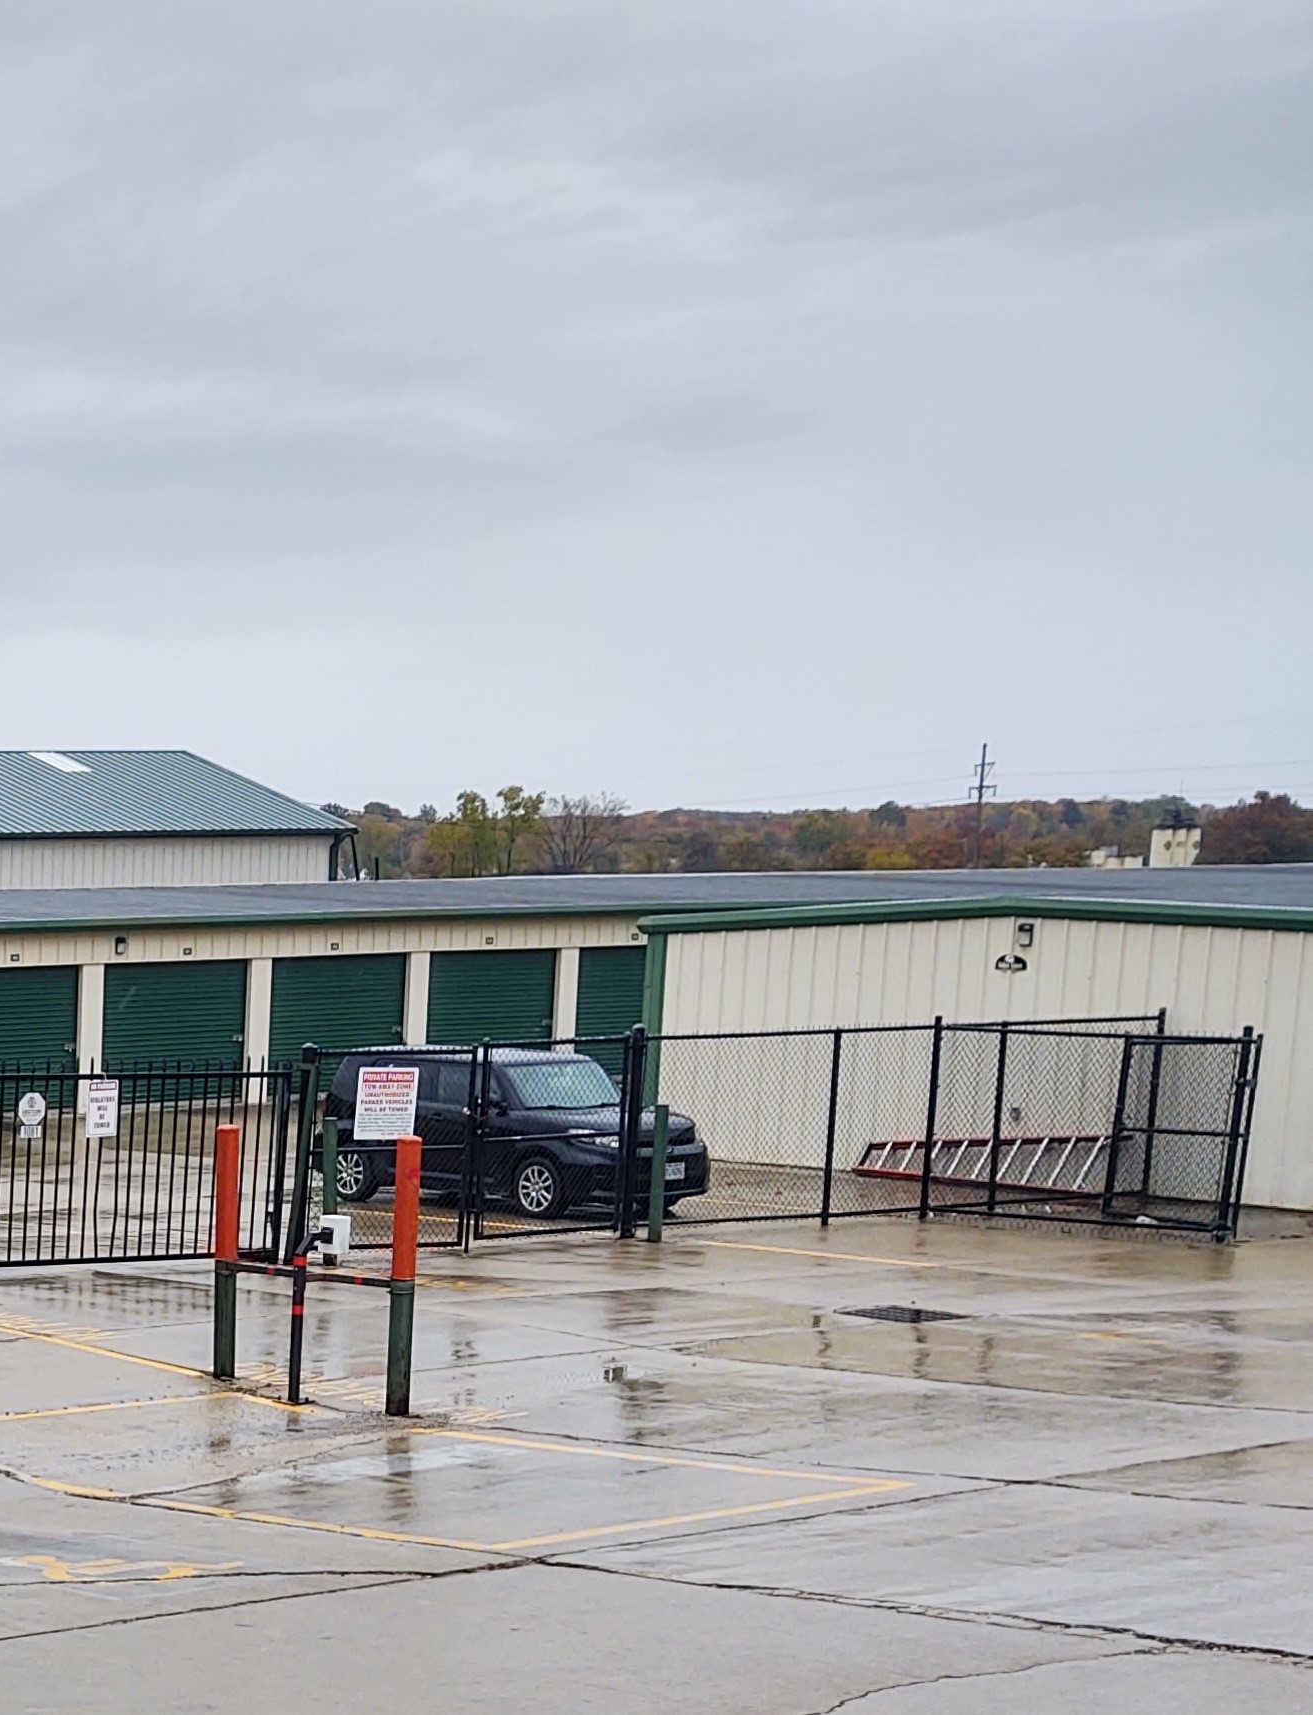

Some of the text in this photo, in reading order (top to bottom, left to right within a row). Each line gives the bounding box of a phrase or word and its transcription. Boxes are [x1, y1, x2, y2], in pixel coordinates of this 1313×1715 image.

[363, 1073, 414, 1081] PRIVATE PARKING
[23, 1126, 39, 1137] 1081
